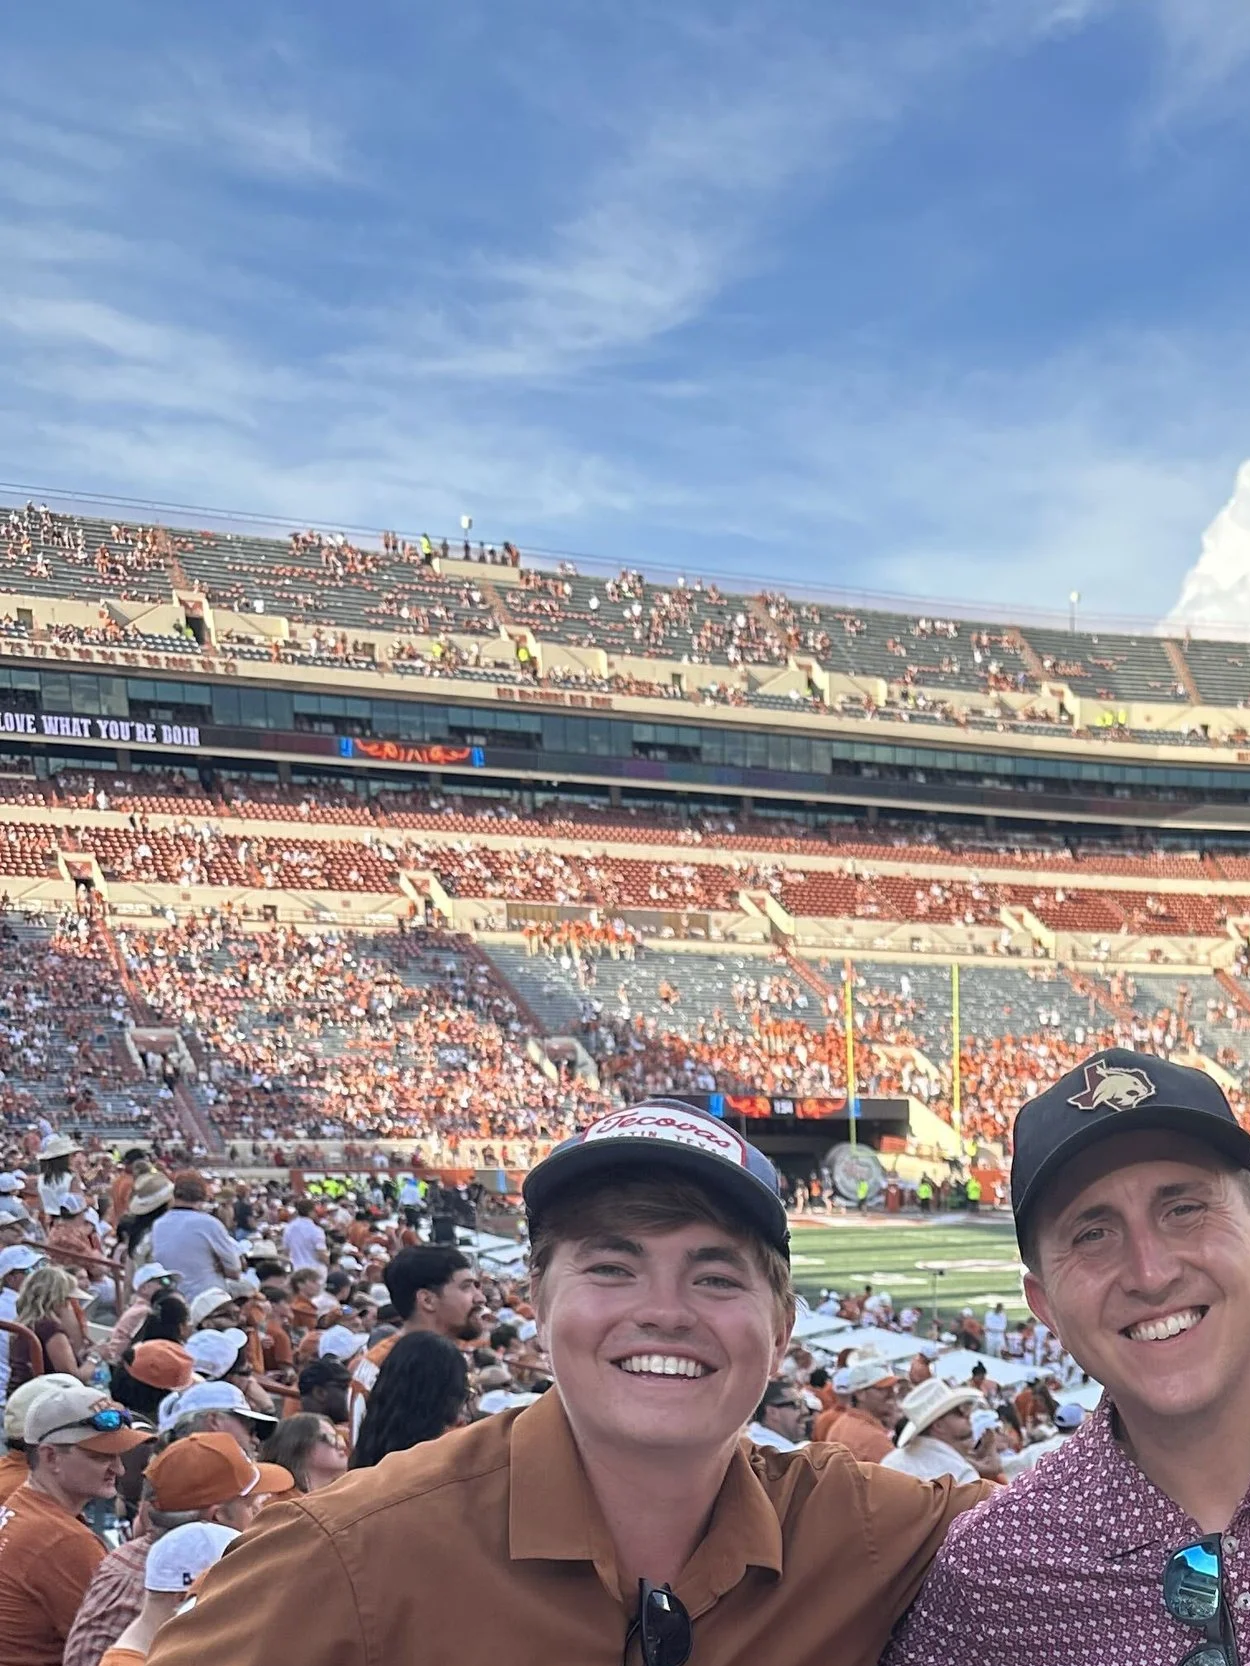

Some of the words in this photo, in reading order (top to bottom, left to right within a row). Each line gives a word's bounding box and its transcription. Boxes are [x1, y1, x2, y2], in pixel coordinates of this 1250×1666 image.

[41, 715, 91, 738] WHAT
[97, 720, 157, 743] YOU'RE
[161, 725, 200, 746] DOIN
[597, 1112, 731, 1148] Tecovas
